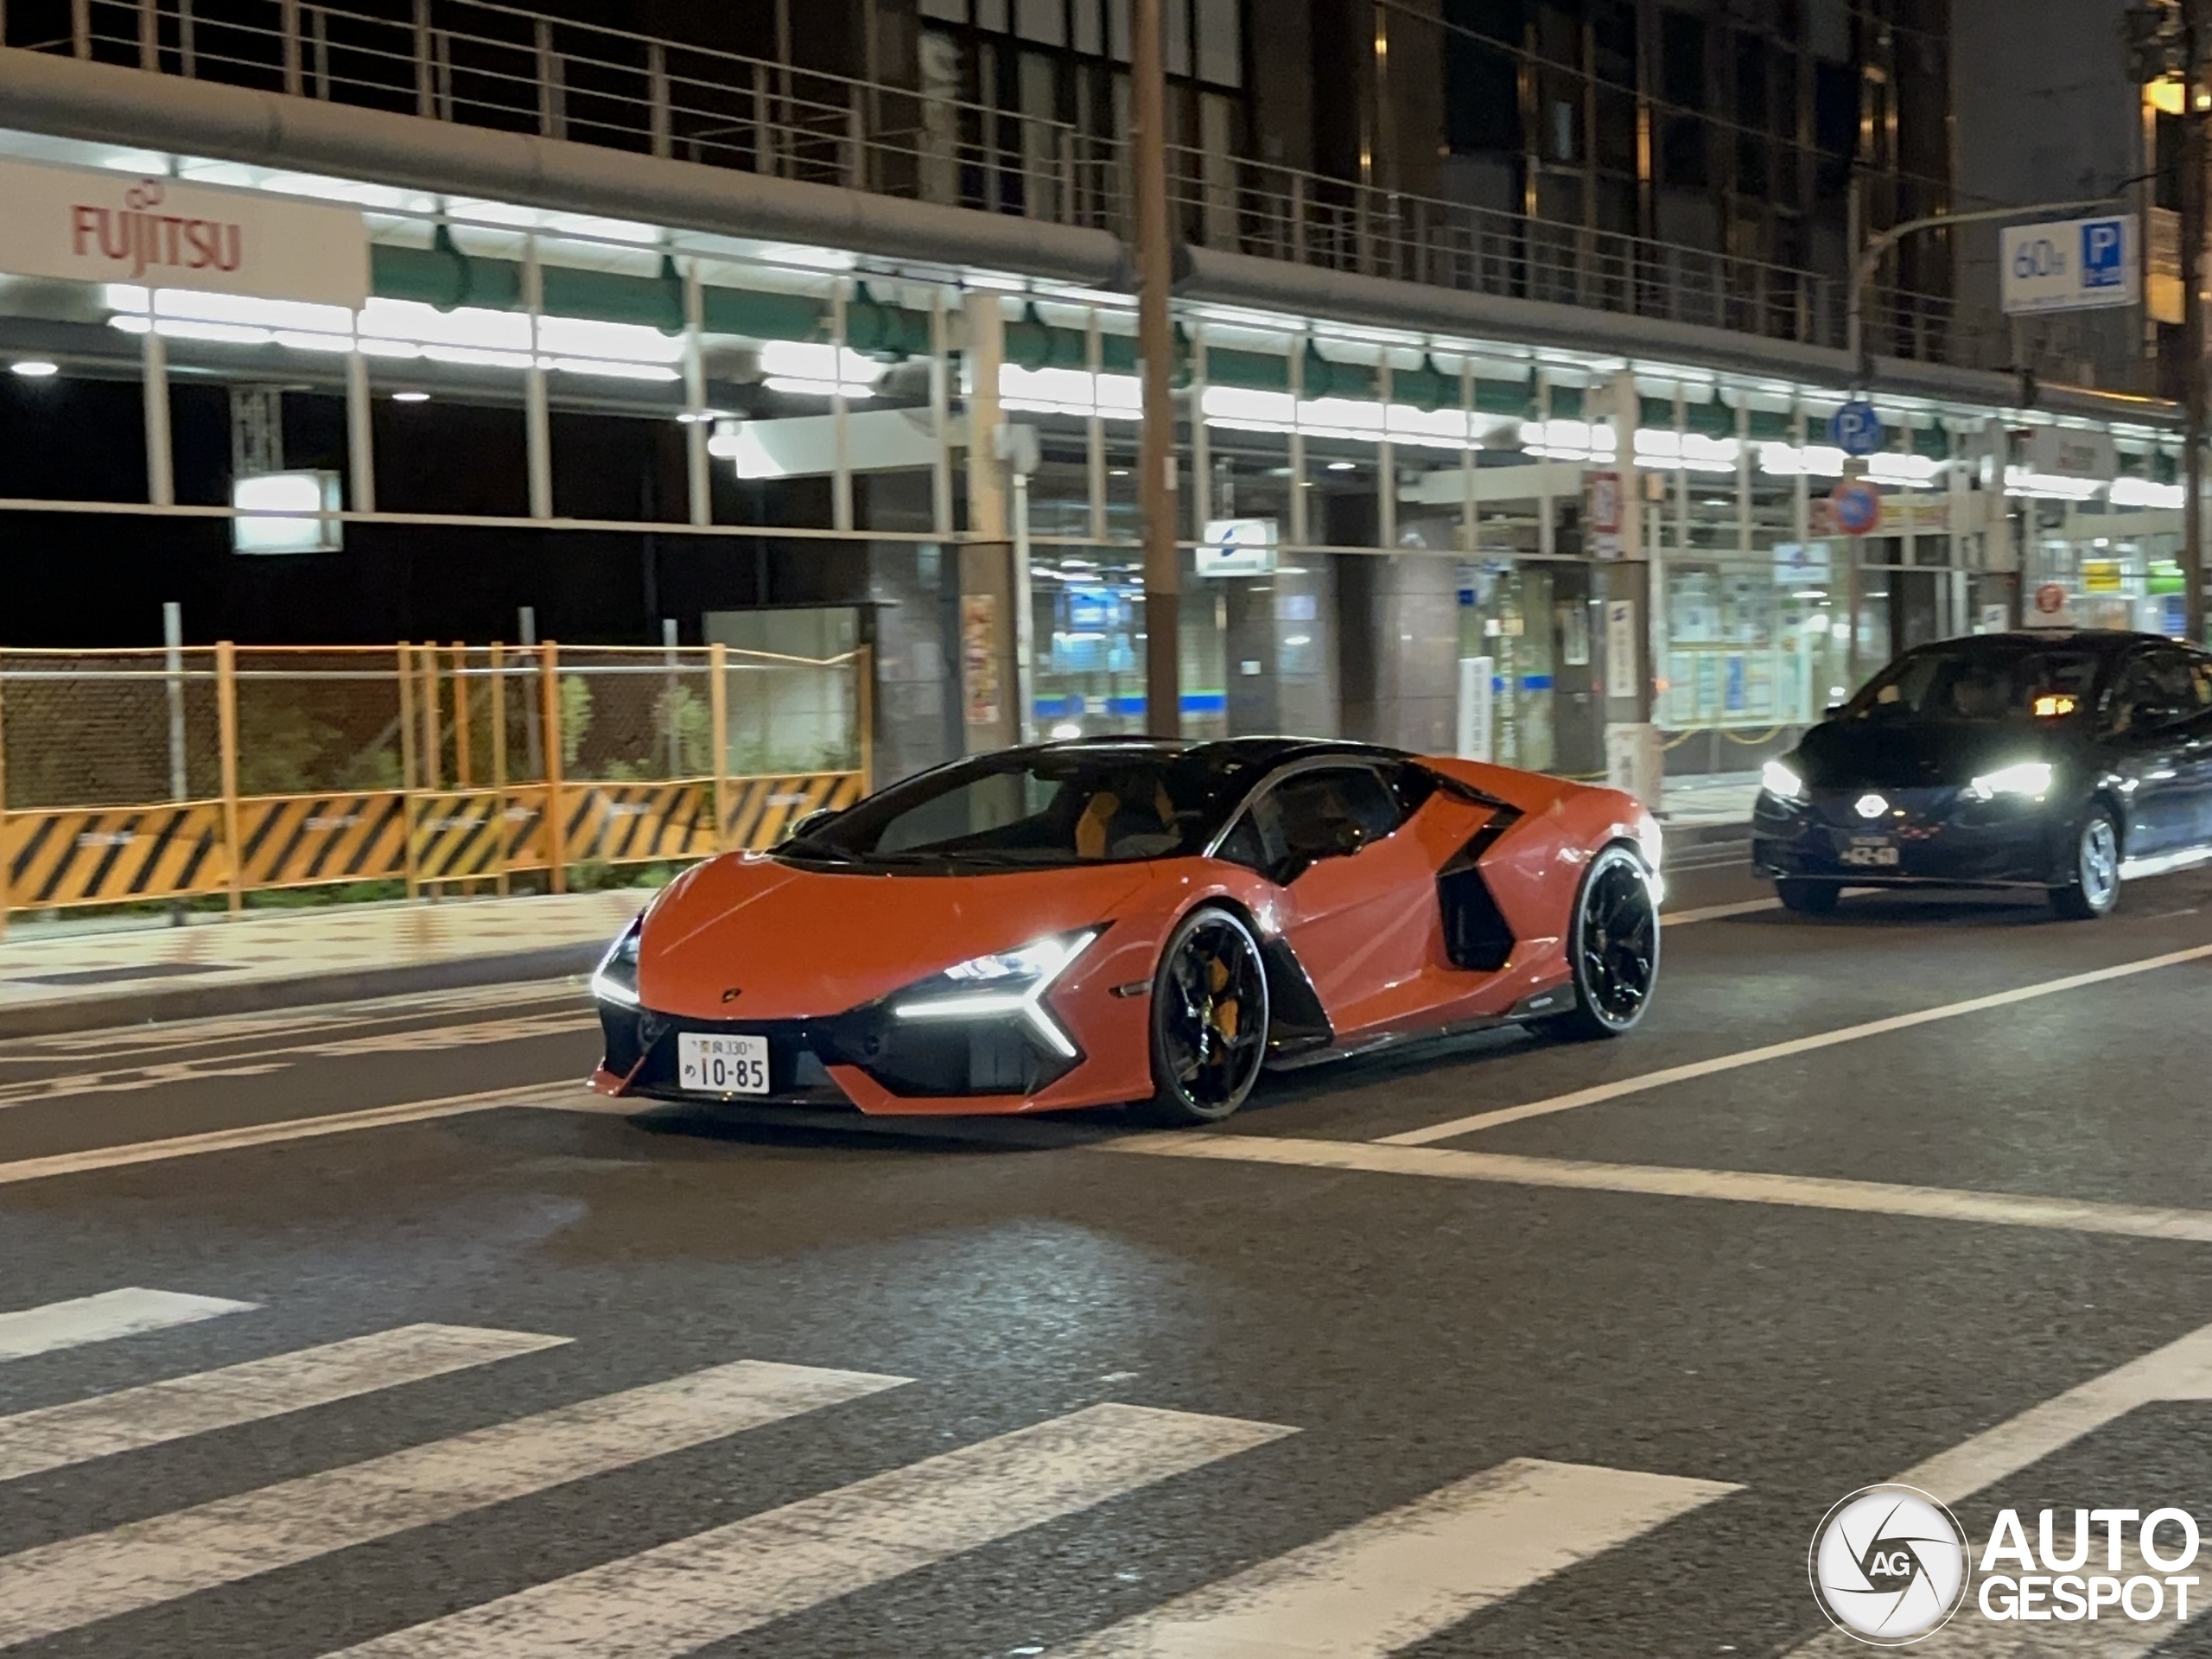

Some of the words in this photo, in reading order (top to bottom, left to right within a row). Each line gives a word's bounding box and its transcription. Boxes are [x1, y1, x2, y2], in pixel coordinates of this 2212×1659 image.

[71, 204, 241, 278] FUJITSU
[2089, 227, 2117, 264] P
[702, 1058, 763, 1087] 10-85
